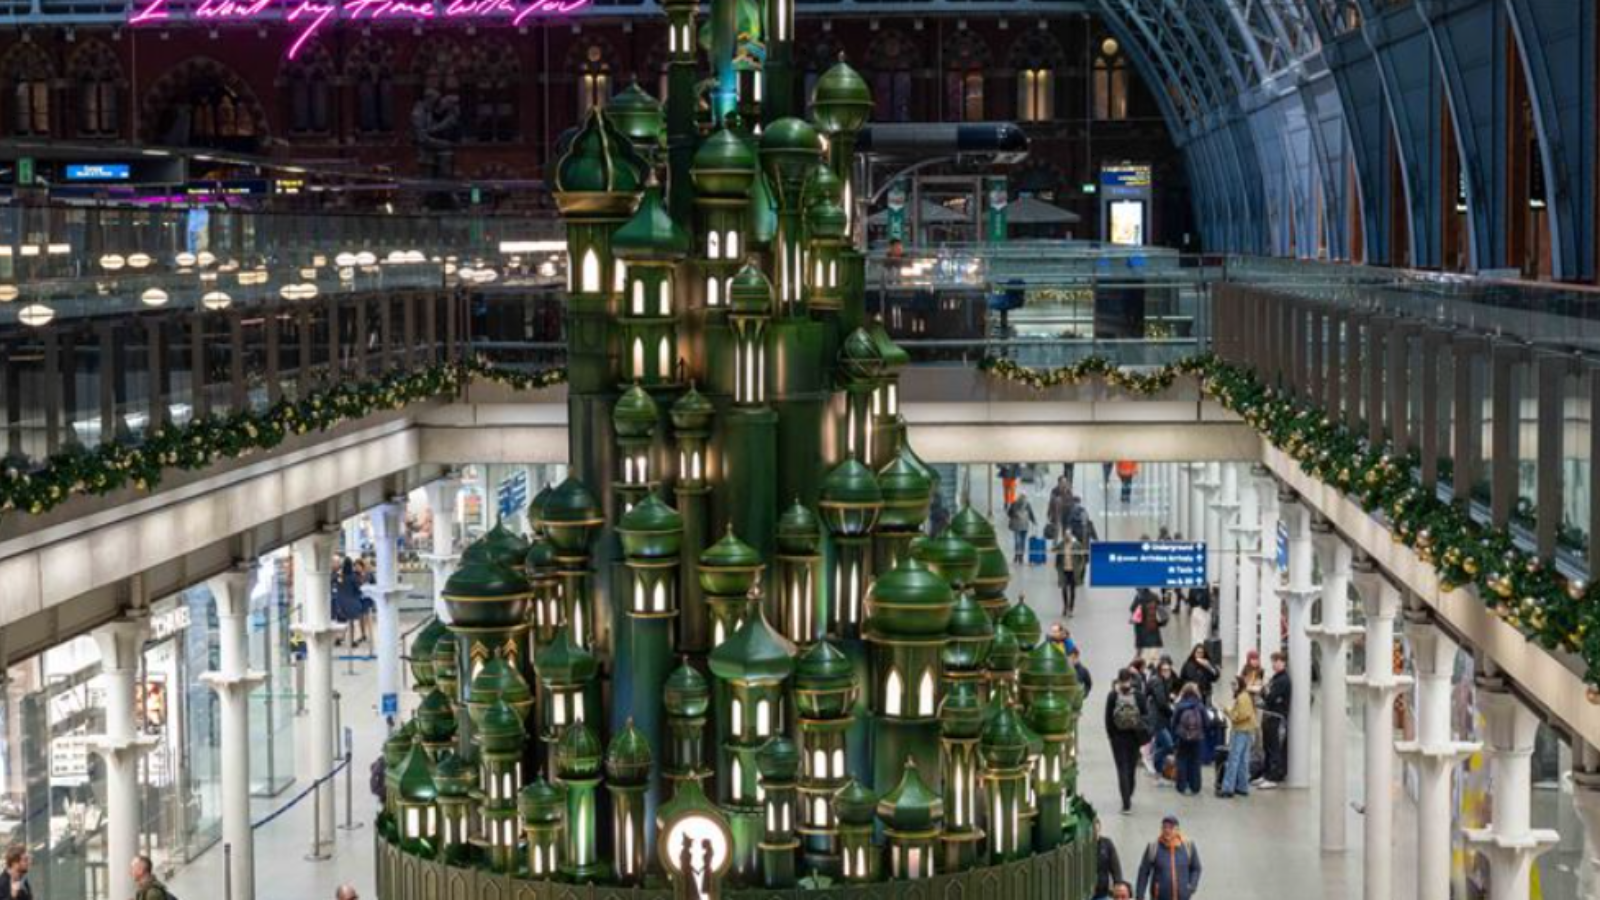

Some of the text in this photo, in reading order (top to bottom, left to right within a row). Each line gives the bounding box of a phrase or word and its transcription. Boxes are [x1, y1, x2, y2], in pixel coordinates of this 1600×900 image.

[129, 0, 168, 24] I
[287, 1, 335, 59] my
[1152, 543, 1193, 552] Underground
